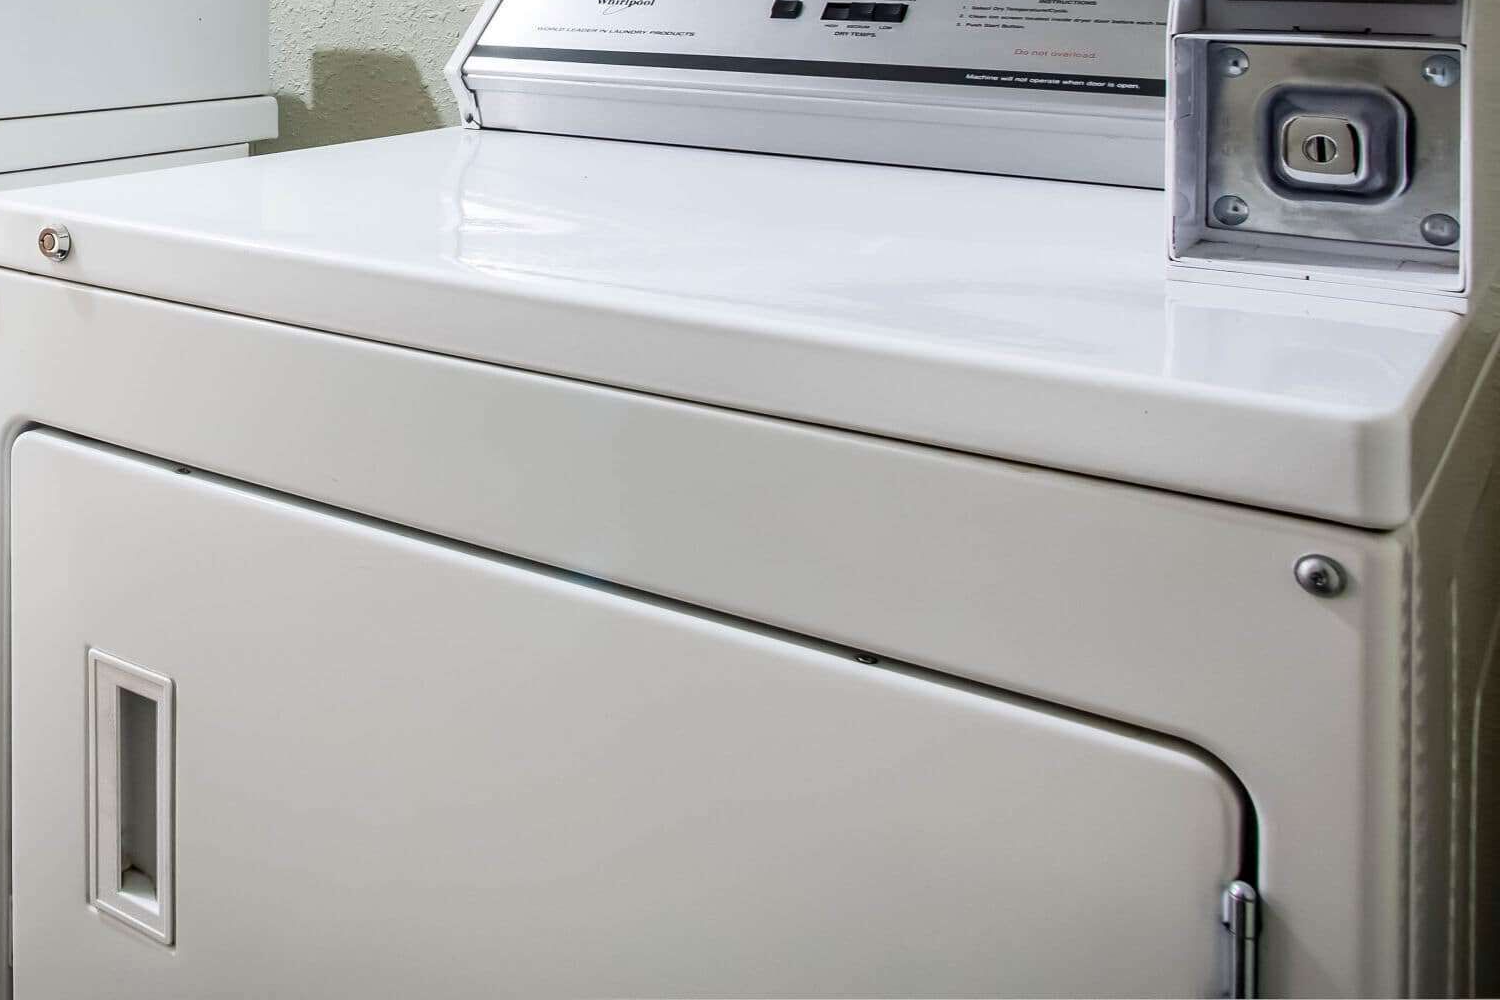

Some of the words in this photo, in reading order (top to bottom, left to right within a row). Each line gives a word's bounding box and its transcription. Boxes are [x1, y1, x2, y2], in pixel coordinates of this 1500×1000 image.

[1014, 48, 1029, 56] Do
[1030, 49, 1049, 57] not
[965, 73, 999, 81] Machine
